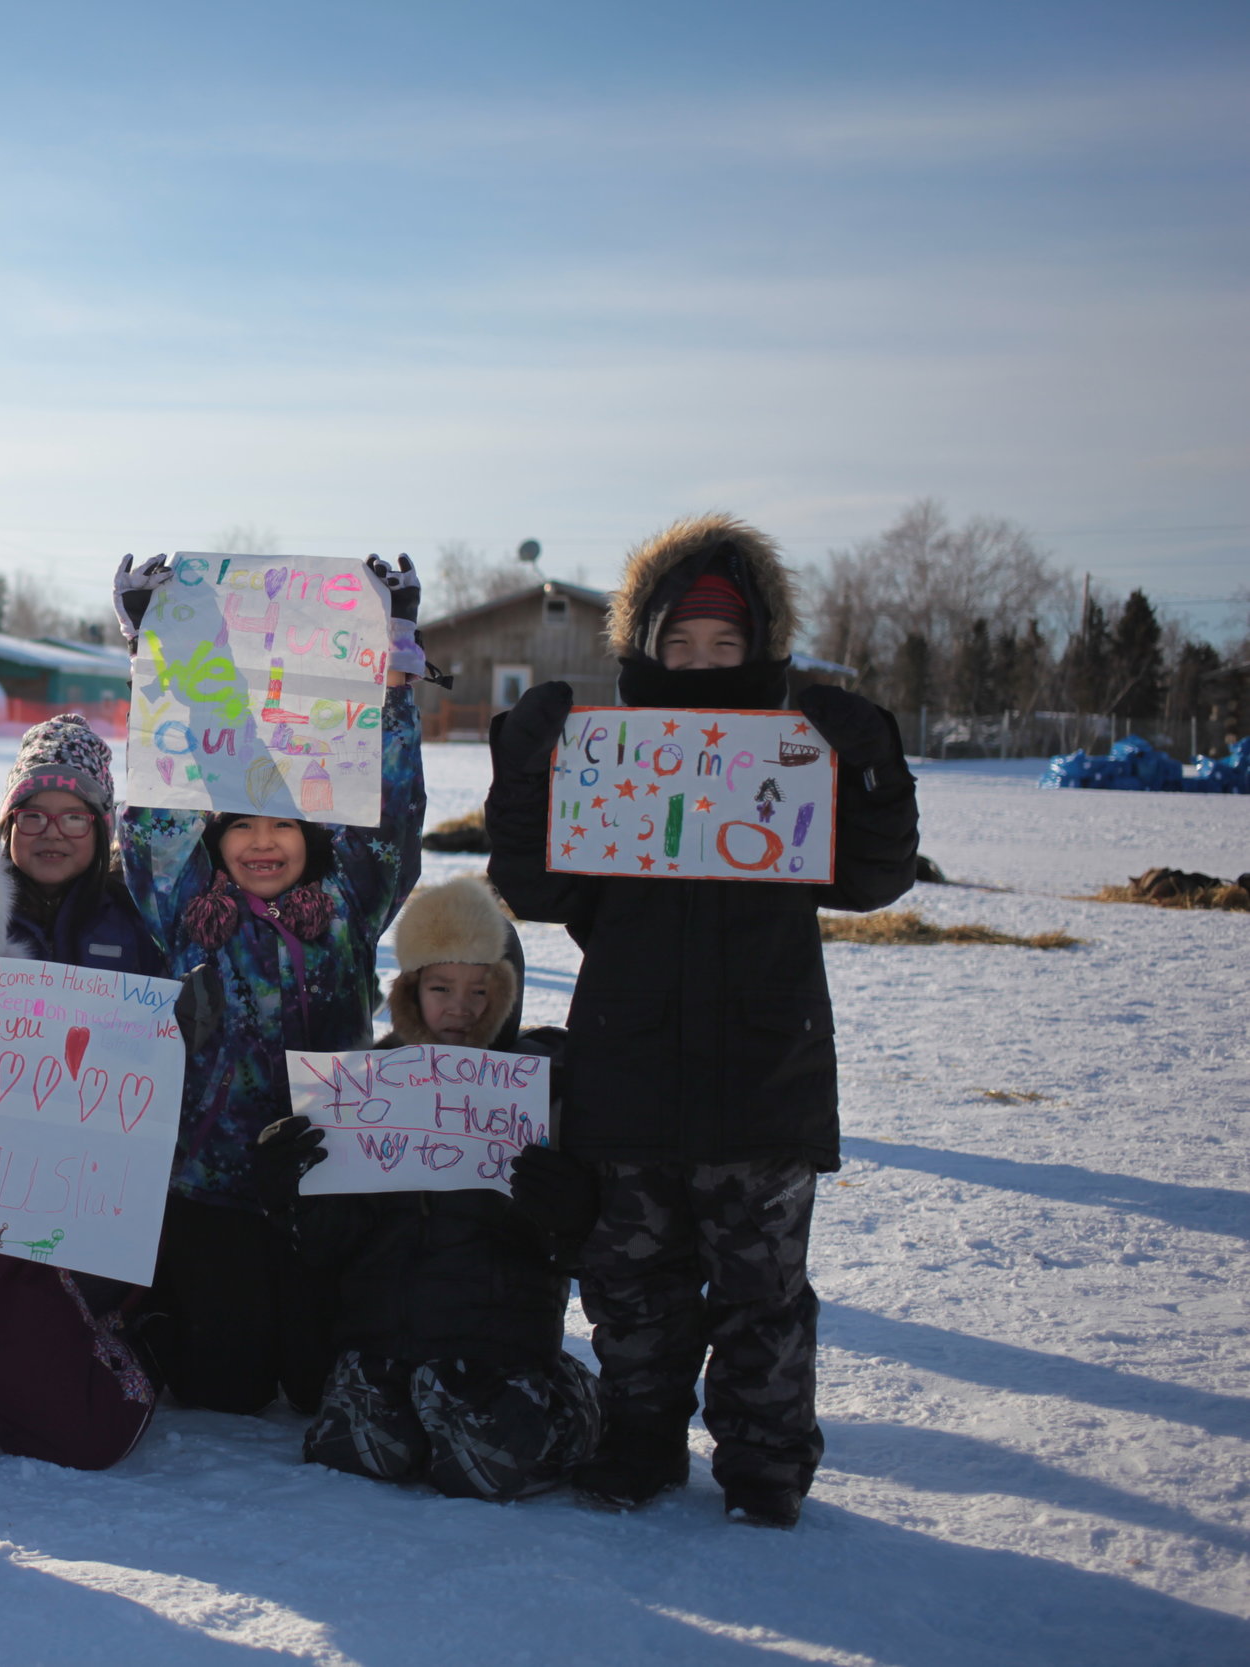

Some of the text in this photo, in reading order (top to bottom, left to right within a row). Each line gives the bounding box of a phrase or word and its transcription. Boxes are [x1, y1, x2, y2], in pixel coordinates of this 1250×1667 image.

[174, 556, 363, 611] elcome
[261, 657, 381, 730] Love
[553, 759, 600, 787] to
[561, 716, 755, 792] Welcome
[39, 961, 54, 987] to
[62, 964, 119, 1000] Huslia!
[122, 973, 174, 1014] Way
[5, 1016, 46, 1042] you
[45, 1002, 67, 1021] on
[156, 1019, 179, 1040] We
[413, 1134, 465, 1171] to
